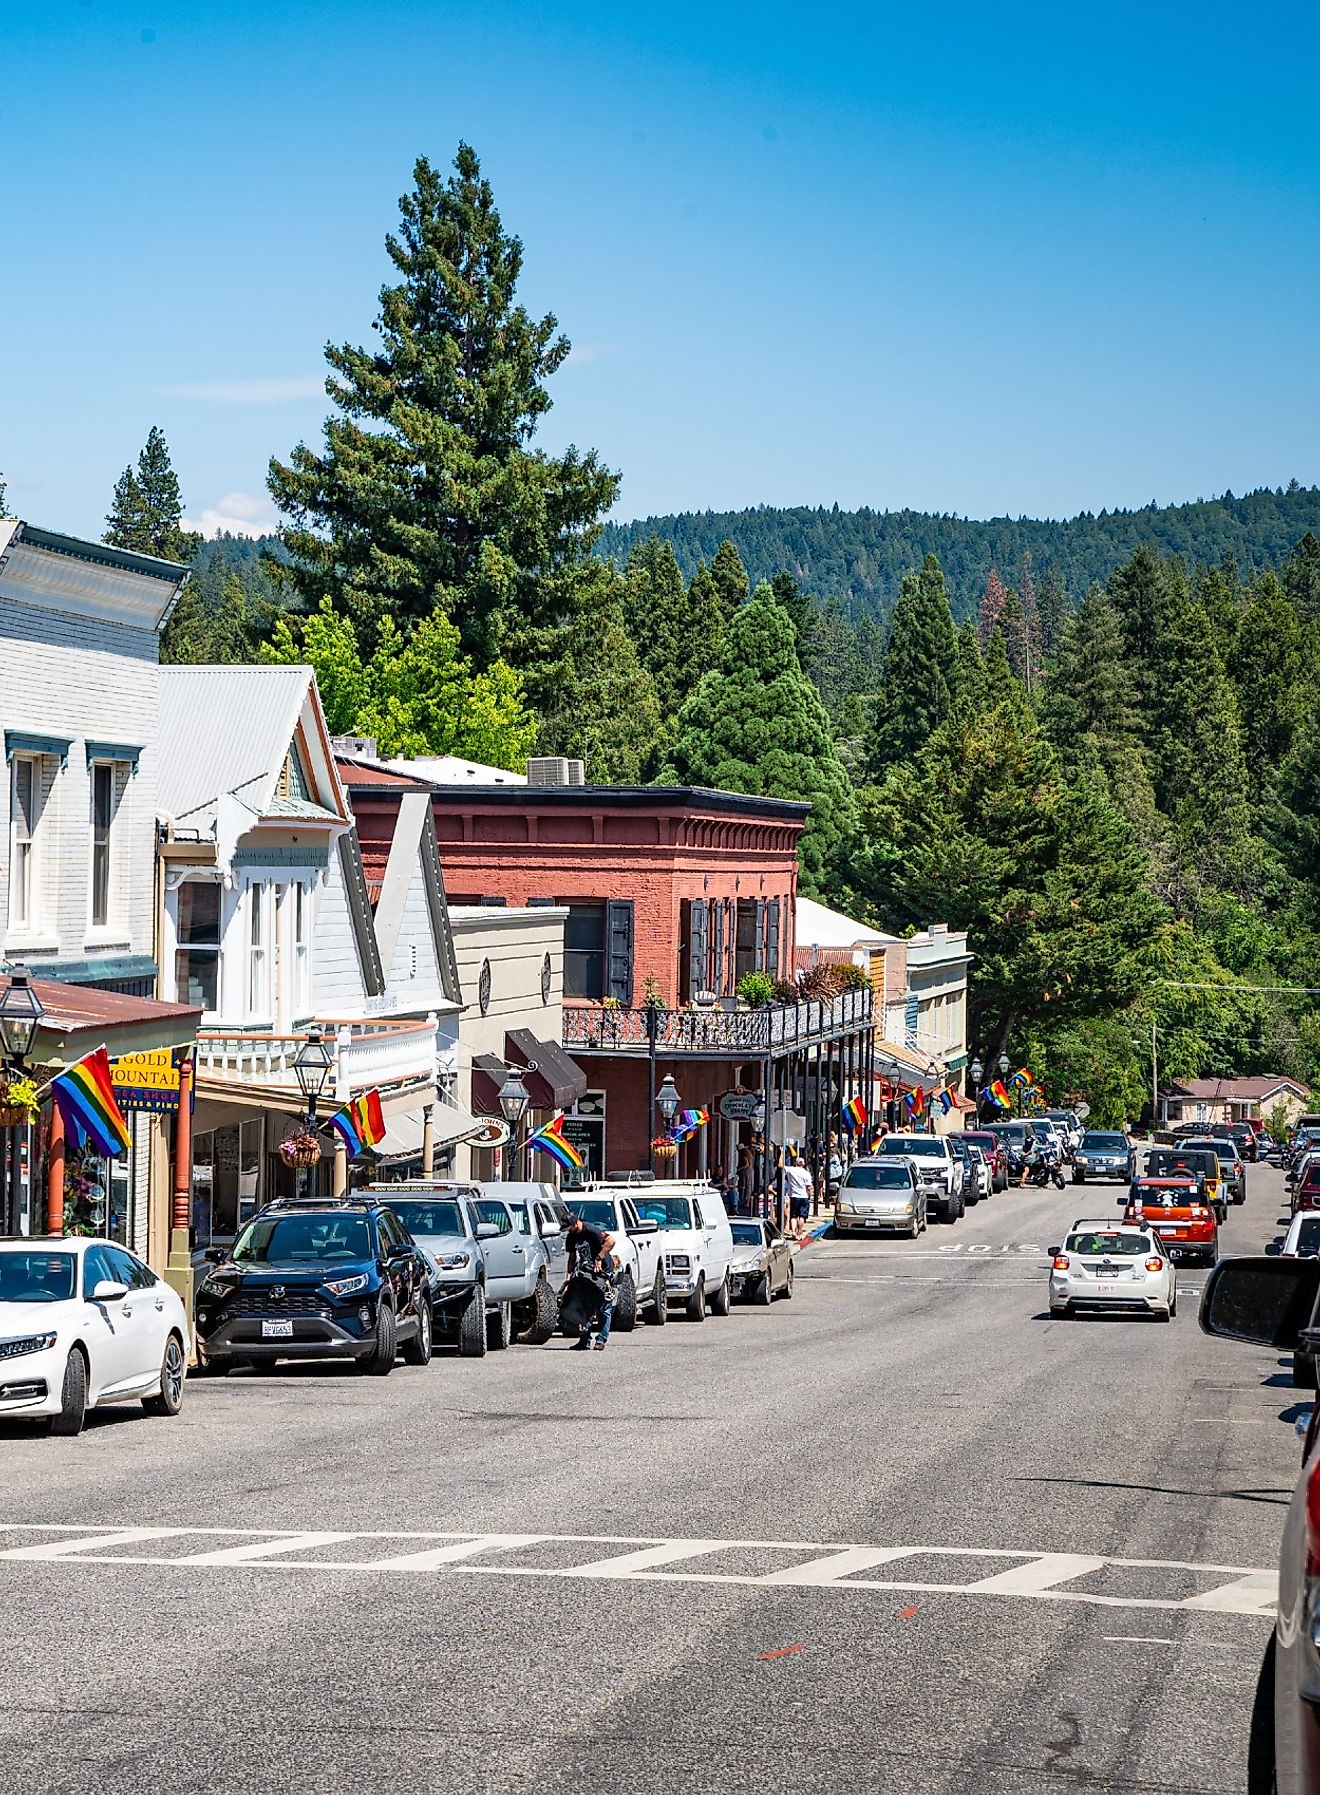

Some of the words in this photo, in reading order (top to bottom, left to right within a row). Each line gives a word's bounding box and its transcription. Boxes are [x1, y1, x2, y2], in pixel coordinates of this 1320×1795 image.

[123, 1053, 167, 1066] GOLD
[110, 1069, 180, 1085] OUNTAI
[114, 1089, 136, 1099] TEA
[143, 1090, 176, 1100] SHOP
[156, 1101, 179, 1109] FIND
